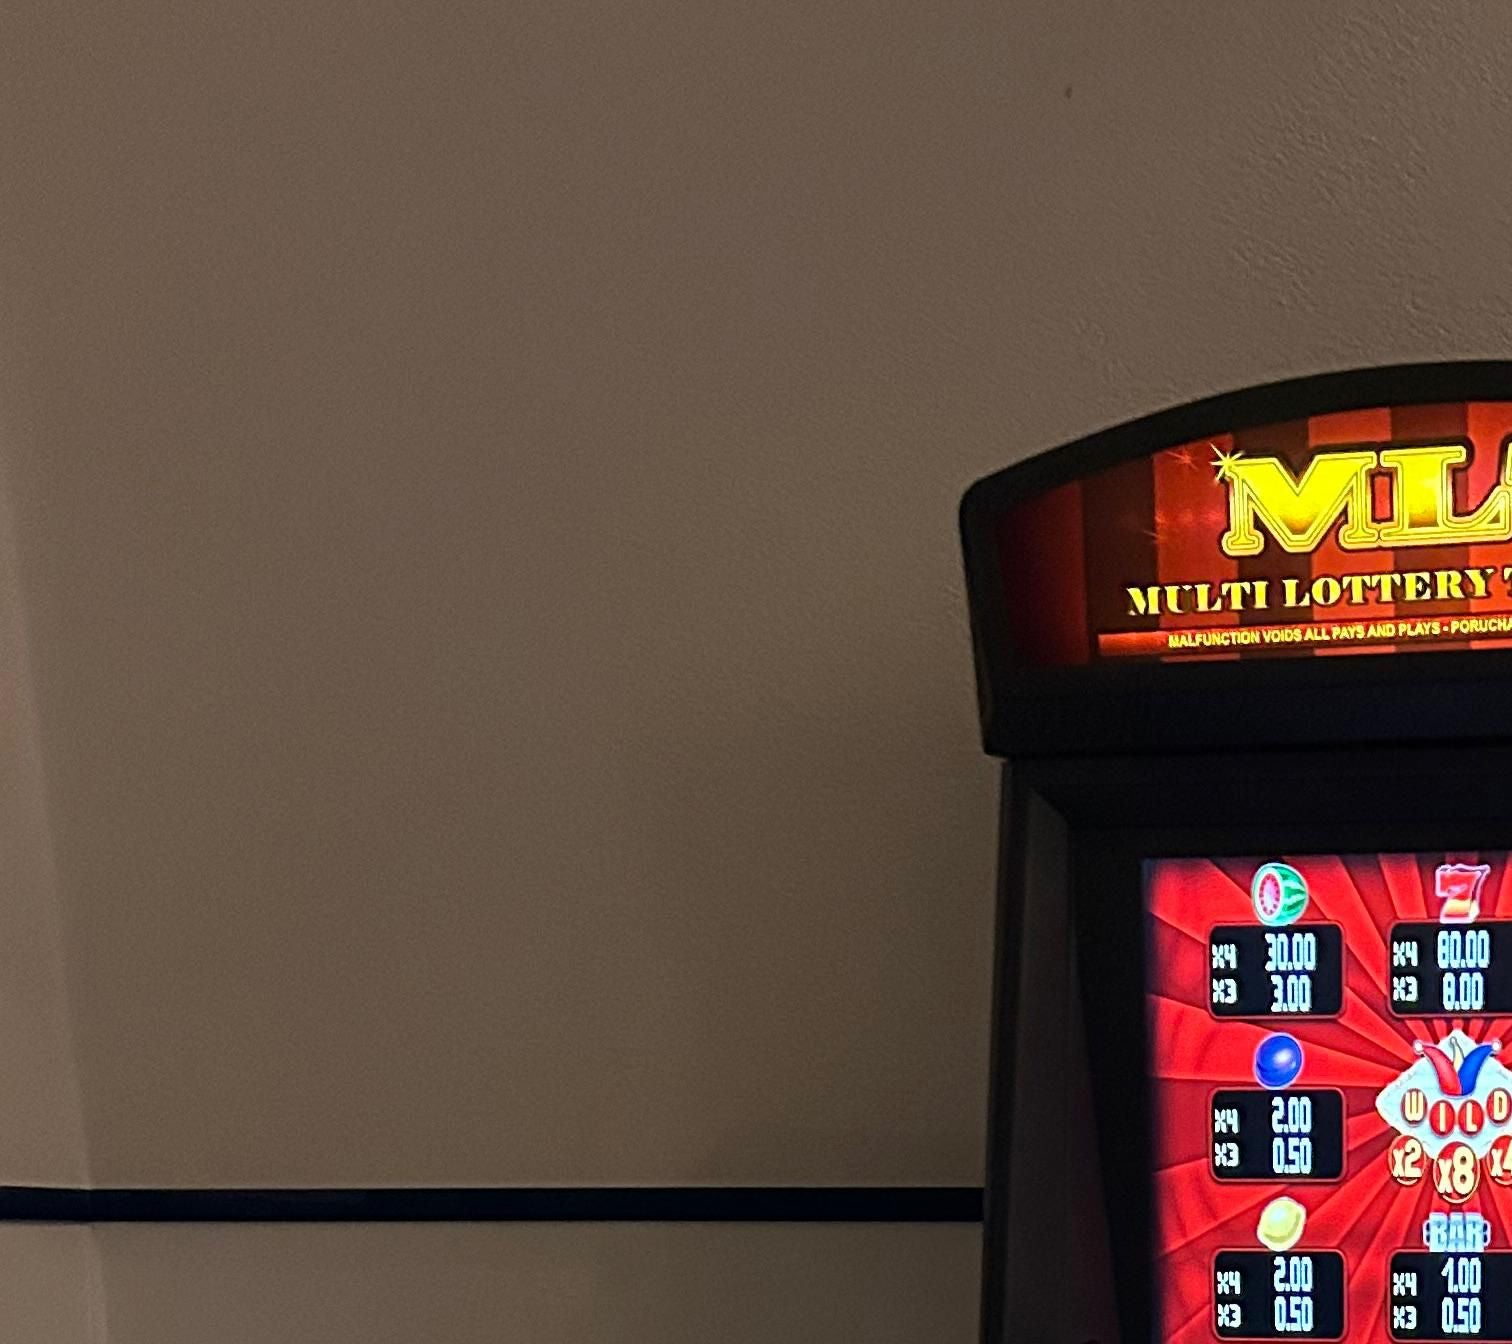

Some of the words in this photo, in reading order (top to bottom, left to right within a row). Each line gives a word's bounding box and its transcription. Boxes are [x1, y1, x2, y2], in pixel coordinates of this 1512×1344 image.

[1126, 580, 1268, 615] MULTI
[1282, 567, 1496, 607] LOTTERY
[1168, 630, 1259, 648] MALFUNCTION
[1261, 628, 1301, 645] VOIDS
[1303, 626, 1330, 642] ALL
[1331, 624, 1365, 640] PAYS
[1367, 622, 1396, 638] AND
[1398, 620, 1441, 637] PLAYS
[1265, 933, 1316, 972] 30.00
[1270, 975, 1311, 1013] 3.00
[1272, 1096, 1311, 1134] 2.00
[1404, 1090, 1507, 1132] WILD
[1273, 1137, 1311, 1174] 0.50
[1430, 1212, 1484, 1253] BAR
[1274, 1257, 1313, 1293] 2.00
[1441, 1257, 1481, 1294] 1.00
[1275, 1296, 1313, 1333] 0.50
[1442, 1298, 1481, 1334] 0.50
